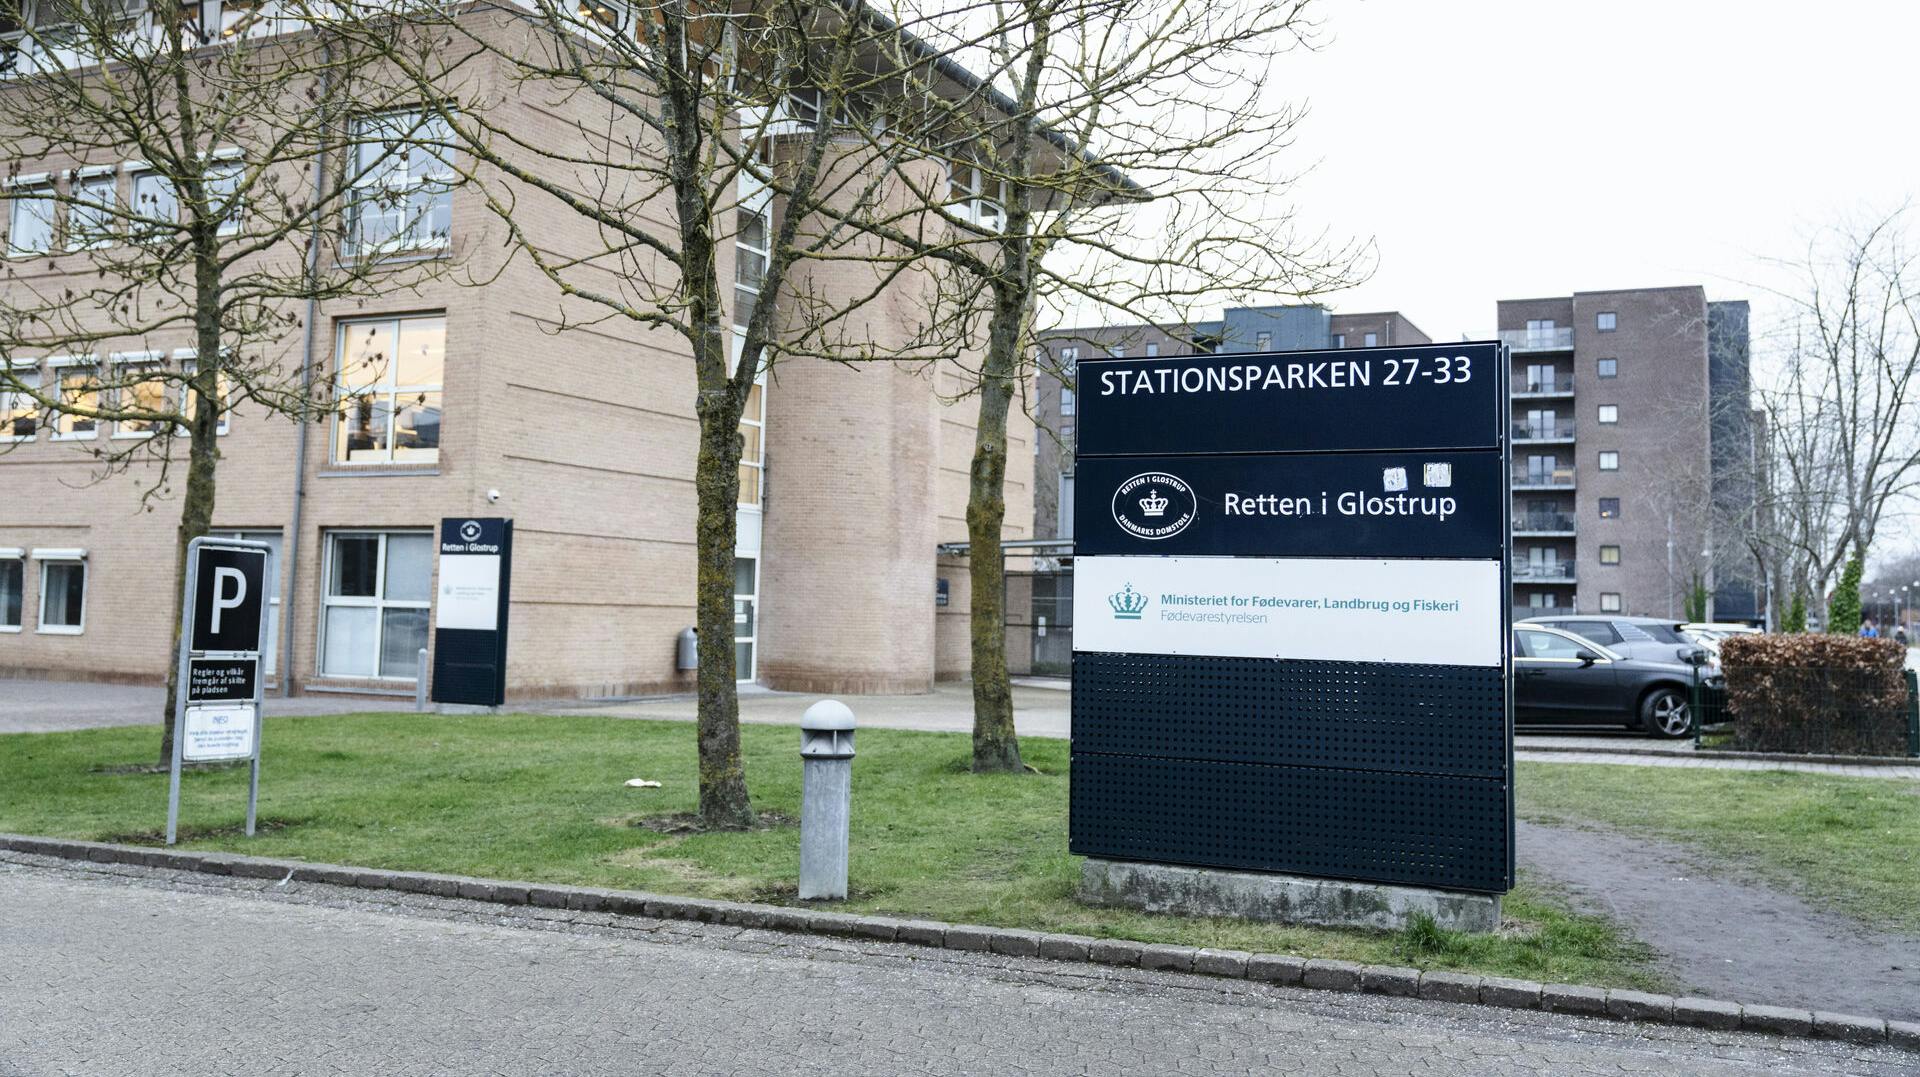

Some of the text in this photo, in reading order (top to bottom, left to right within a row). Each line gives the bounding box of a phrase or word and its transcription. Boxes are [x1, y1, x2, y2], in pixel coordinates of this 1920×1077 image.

[1101, 356, 1472, 396] STATIONSPARKEN 27-33
[1121, 477, 1146, 495] RETTEN
[1152, 476, 1186, 492] GLOSTRUP
[1225, 491, 1457, 521] Retten i Glostrup
[1119, 512, 1190, 535] DANMARKS DOMSTOLE
[442, 543, 464, 551] Retten
[469, 543, 498, 553] Glostrup
[210, 565, 247, 634] P
[1160, 594, 1459, 613] Ministeriet for Fødevarer, Landbrug og Fiskeri
[1160, 609, 1268, 625] Fødevarestyrelsen
[192, 667, 244, 677] Regler og vilkår
[192, 677, 219, 686] fremgår
[191, 686, 228, 695] på pladsen
